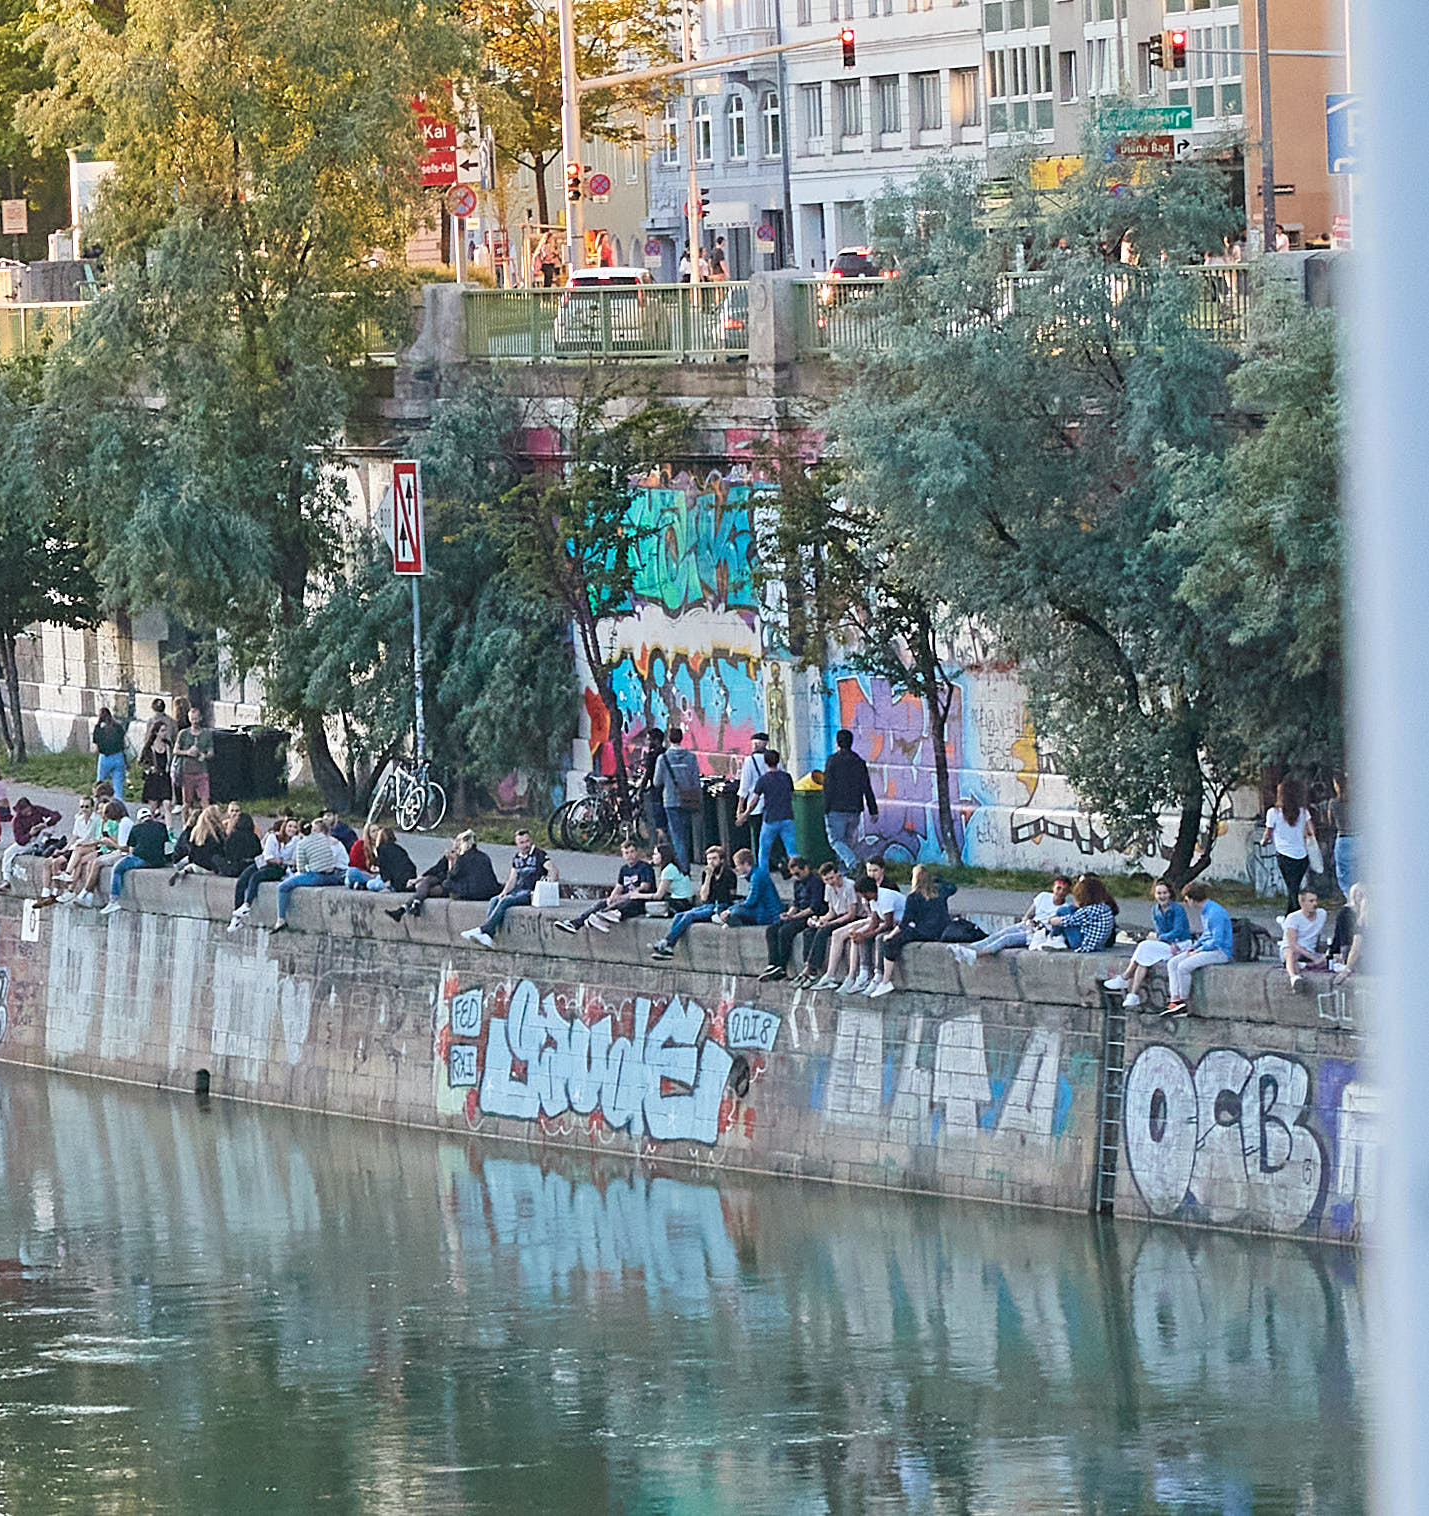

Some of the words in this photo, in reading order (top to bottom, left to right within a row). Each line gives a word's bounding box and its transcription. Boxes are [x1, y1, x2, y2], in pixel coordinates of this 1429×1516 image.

[423, 124, 447, 139] Kai
[1151, 141, 1170, 153] Bad
[422, 160, 455, 174] sefs-Kai
[454, 997, 480, 1029] FED
